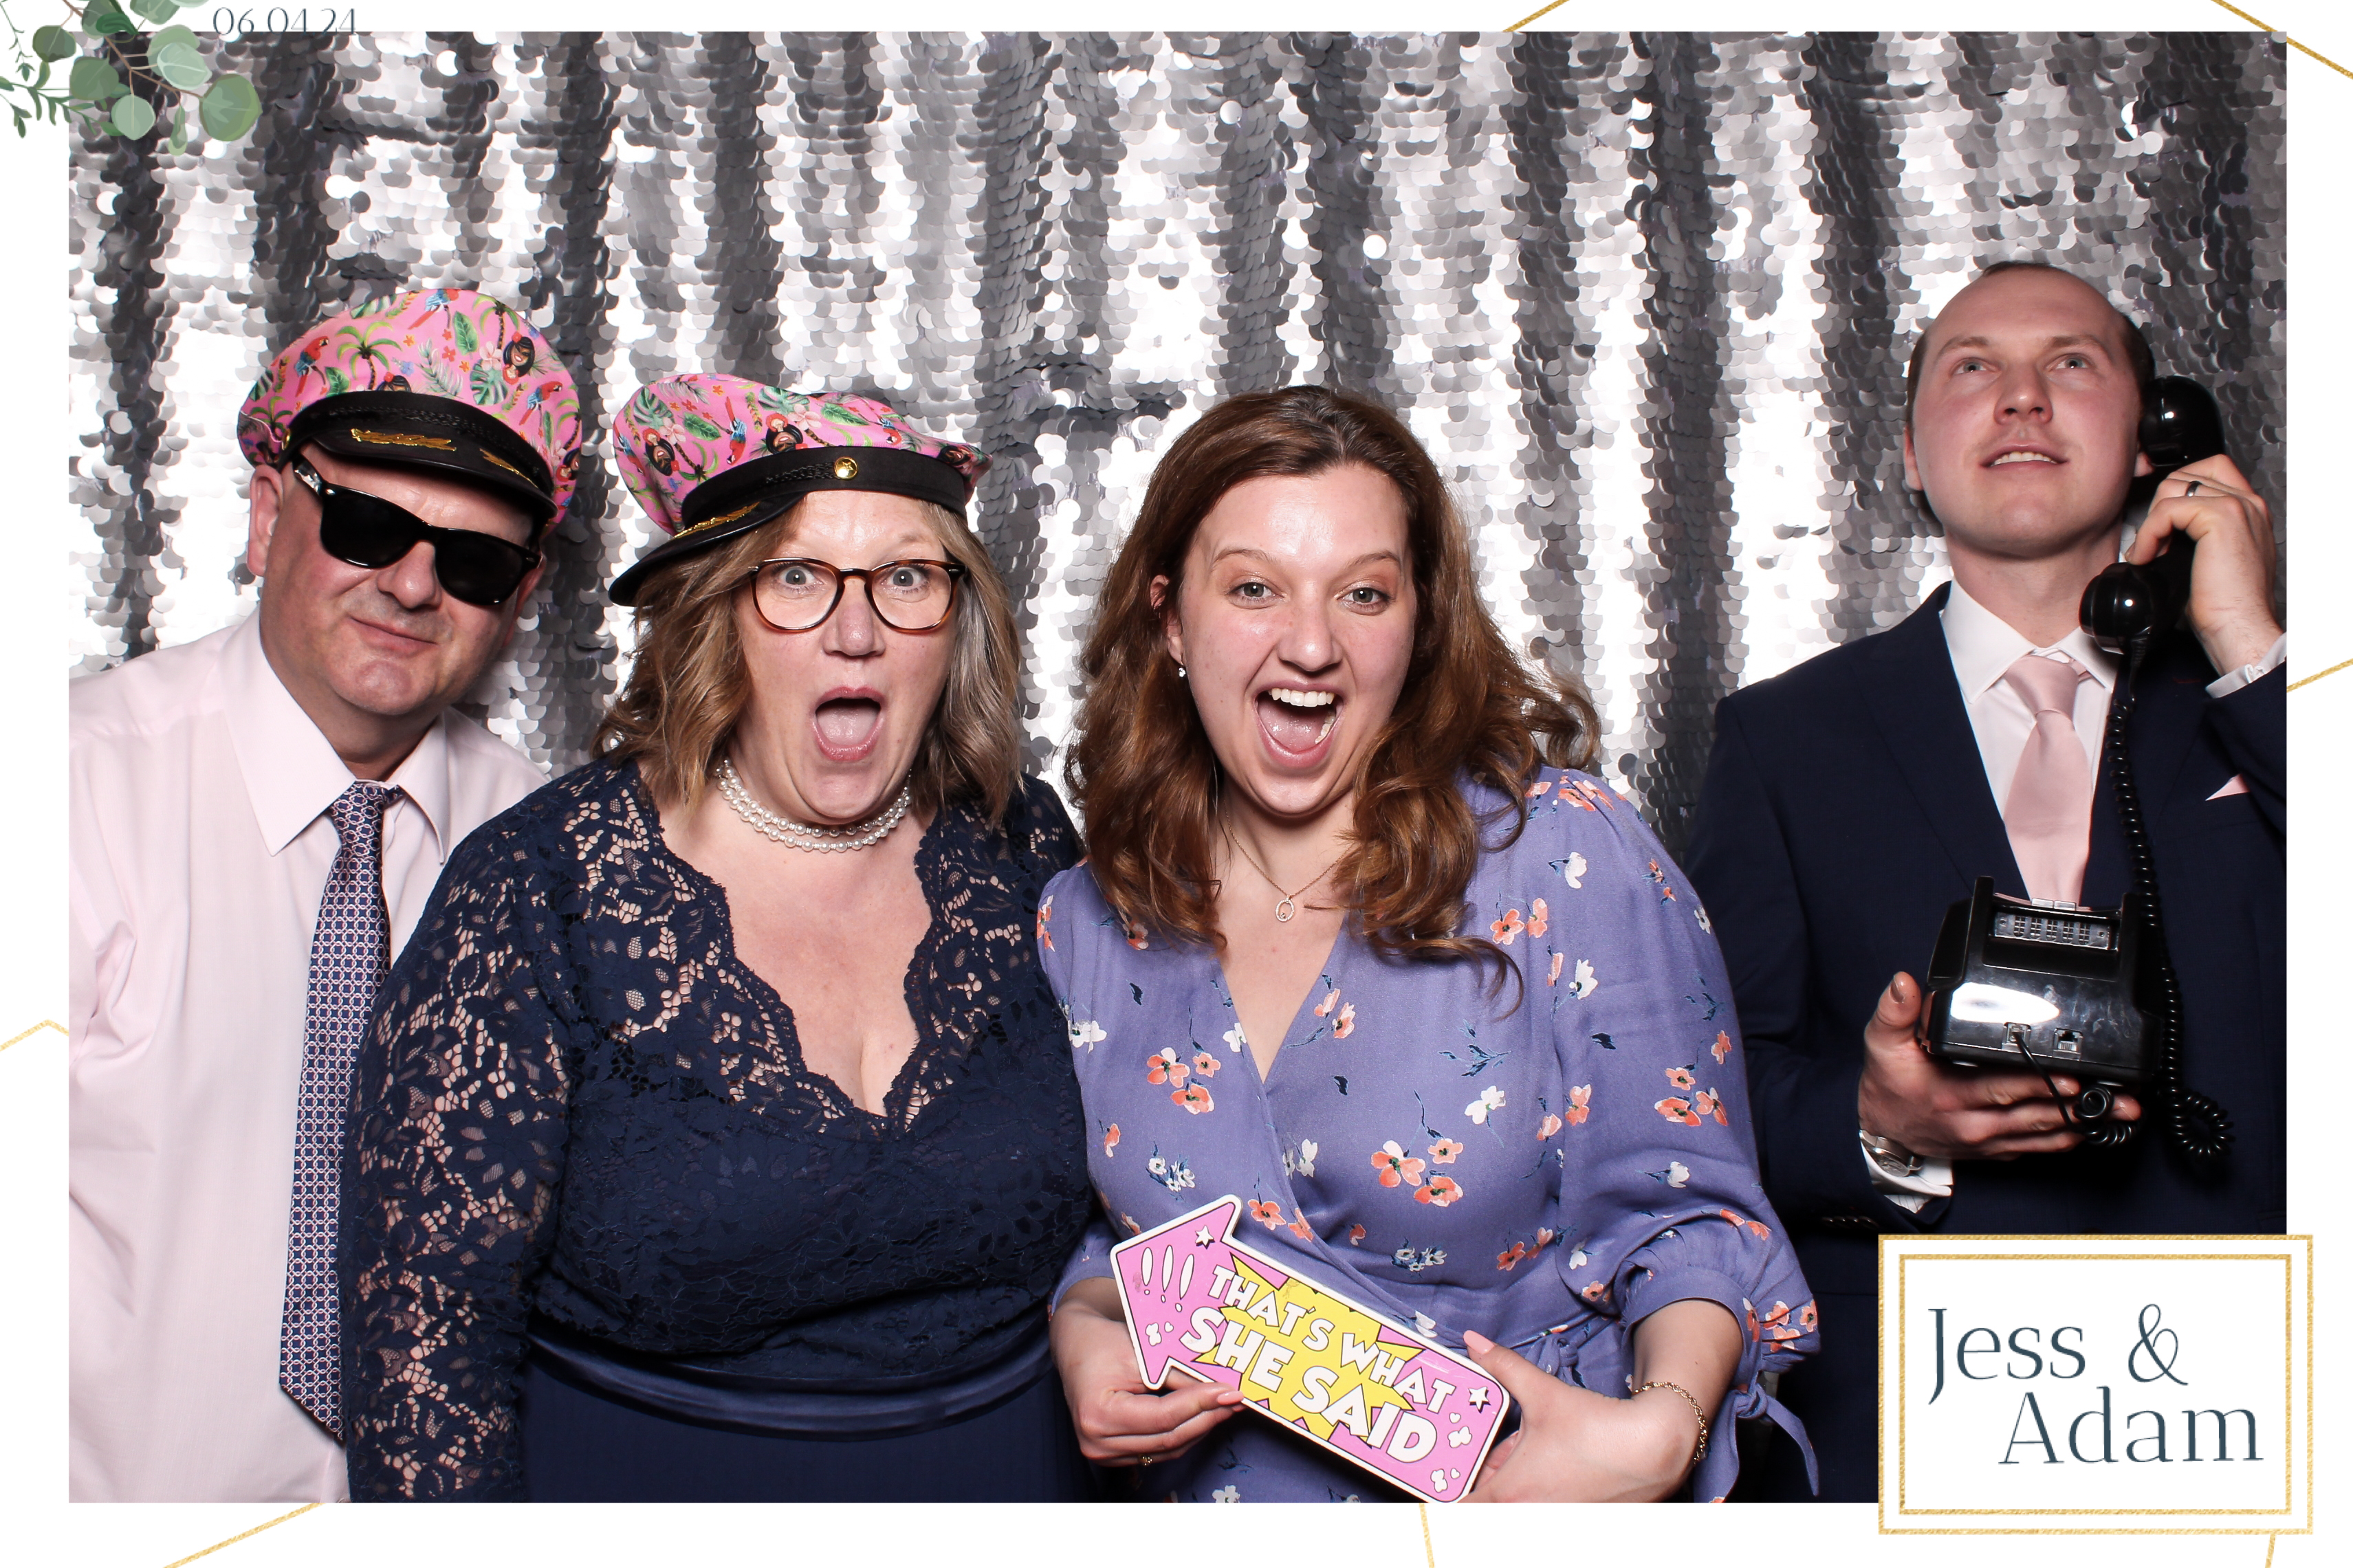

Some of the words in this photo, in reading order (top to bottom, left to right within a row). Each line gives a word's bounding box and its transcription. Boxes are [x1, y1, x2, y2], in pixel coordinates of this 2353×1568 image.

[1179, 1307, 1295, 1393] SHE
[1291, 1365, 1437, 1463] SAID
[1207, 1265, 1335, 1351] THAT'S
[1341, 1332, 1456, 1413] WHAT
